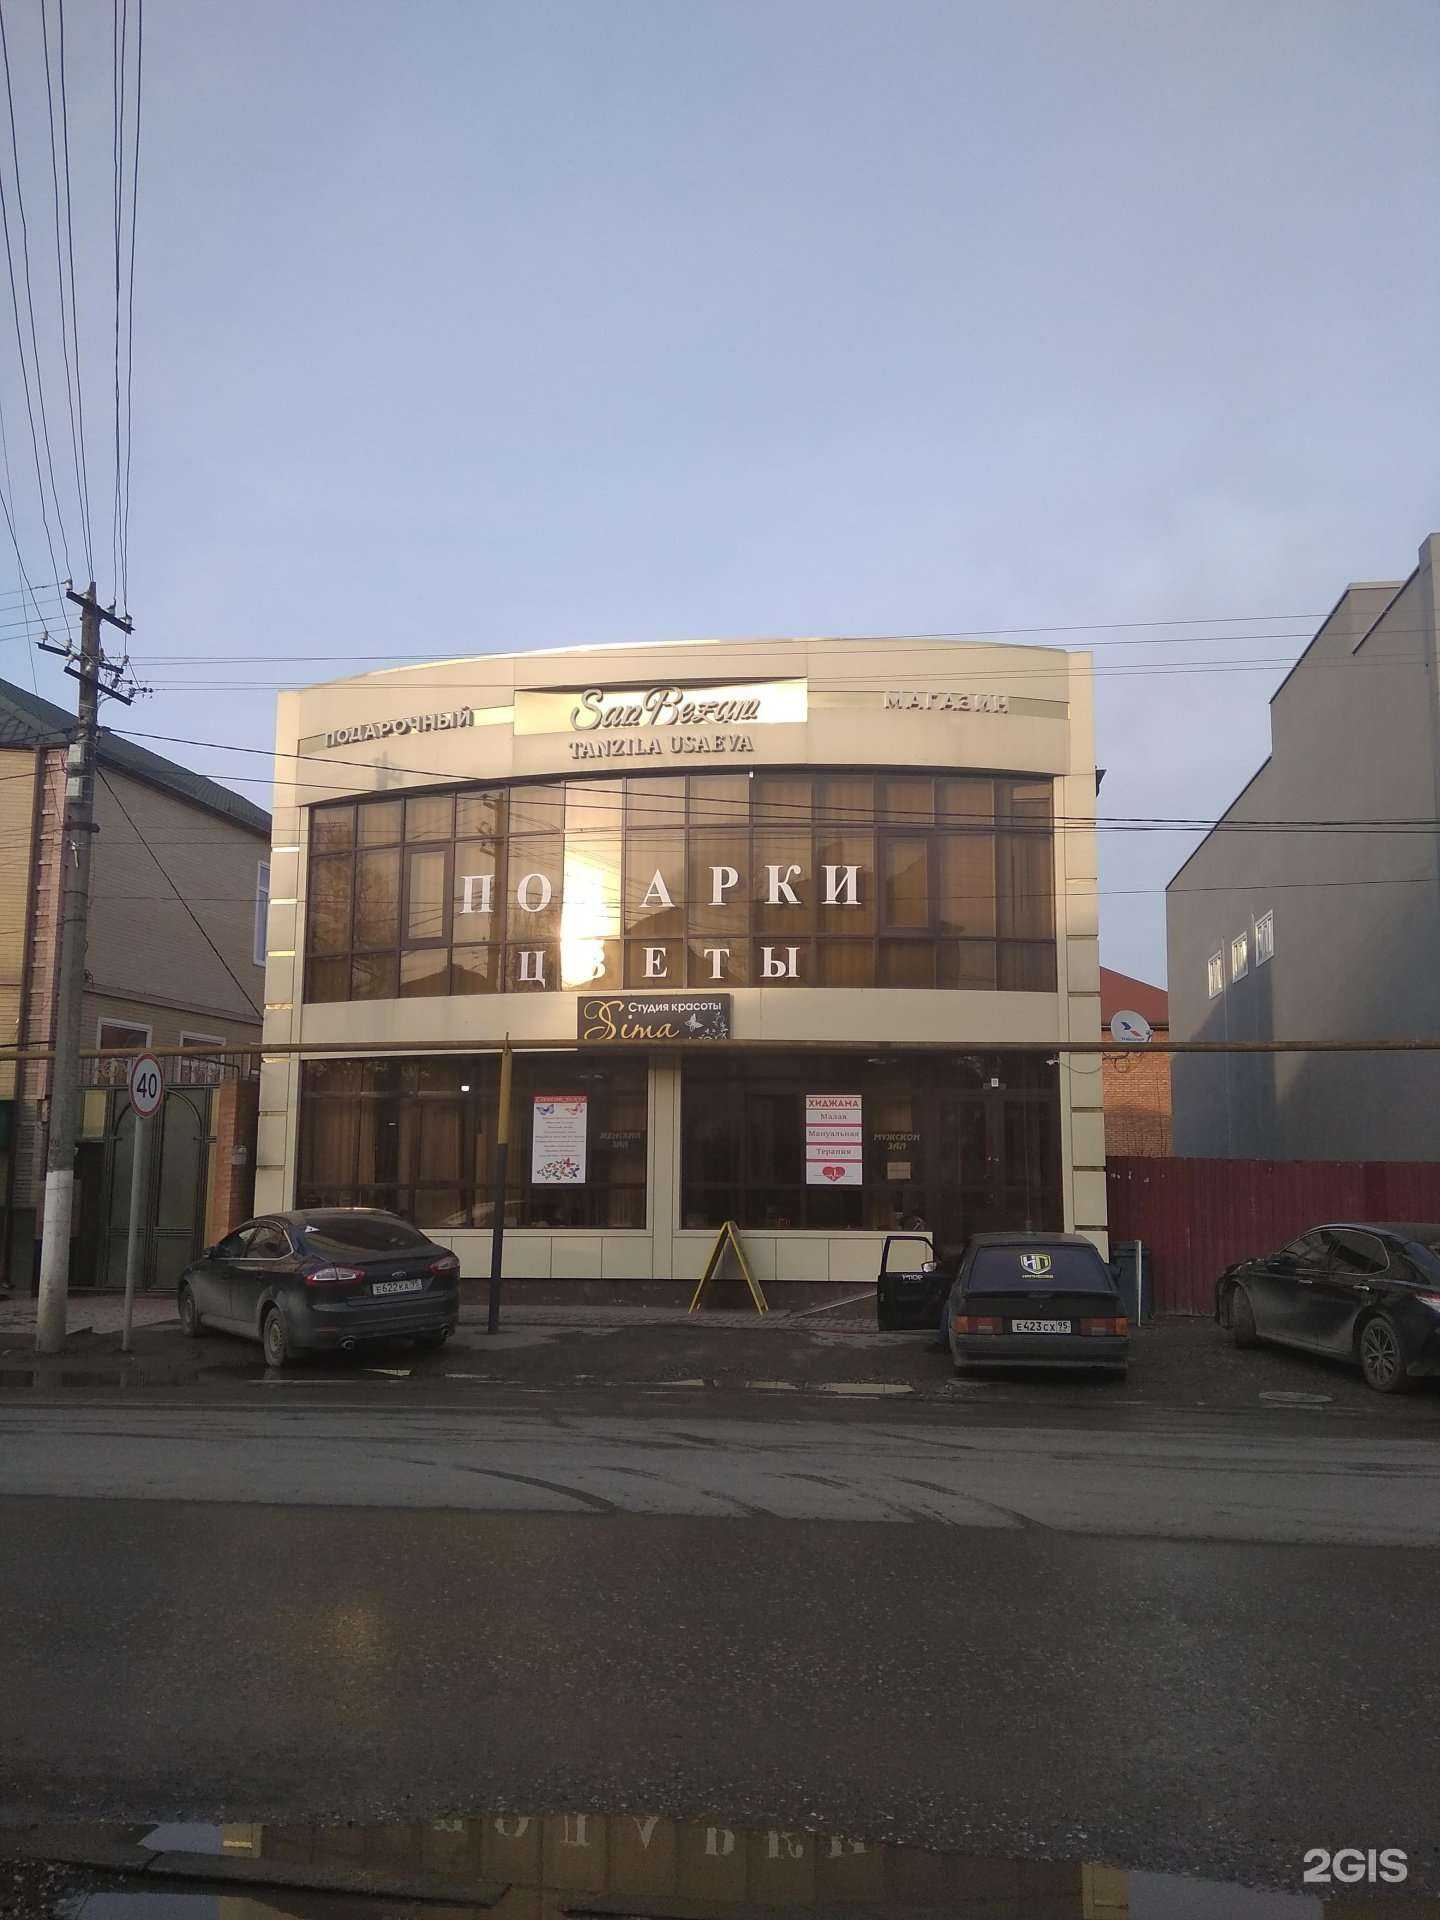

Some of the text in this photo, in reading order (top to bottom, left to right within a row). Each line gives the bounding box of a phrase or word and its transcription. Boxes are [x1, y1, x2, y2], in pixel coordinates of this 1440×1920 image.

[883, 690, 1008, 714] МАГАЗИН
[325, 706, 474, 748] ПОДАРОЧНЫЙ
[568, 734, 755, 760] TANZILA USAEVA
[460, 864, 863, 914] ПОАРКИ
[628, 1001, 722, 1014] Студия красоты
[136, 1072, 157, 1098] 40
